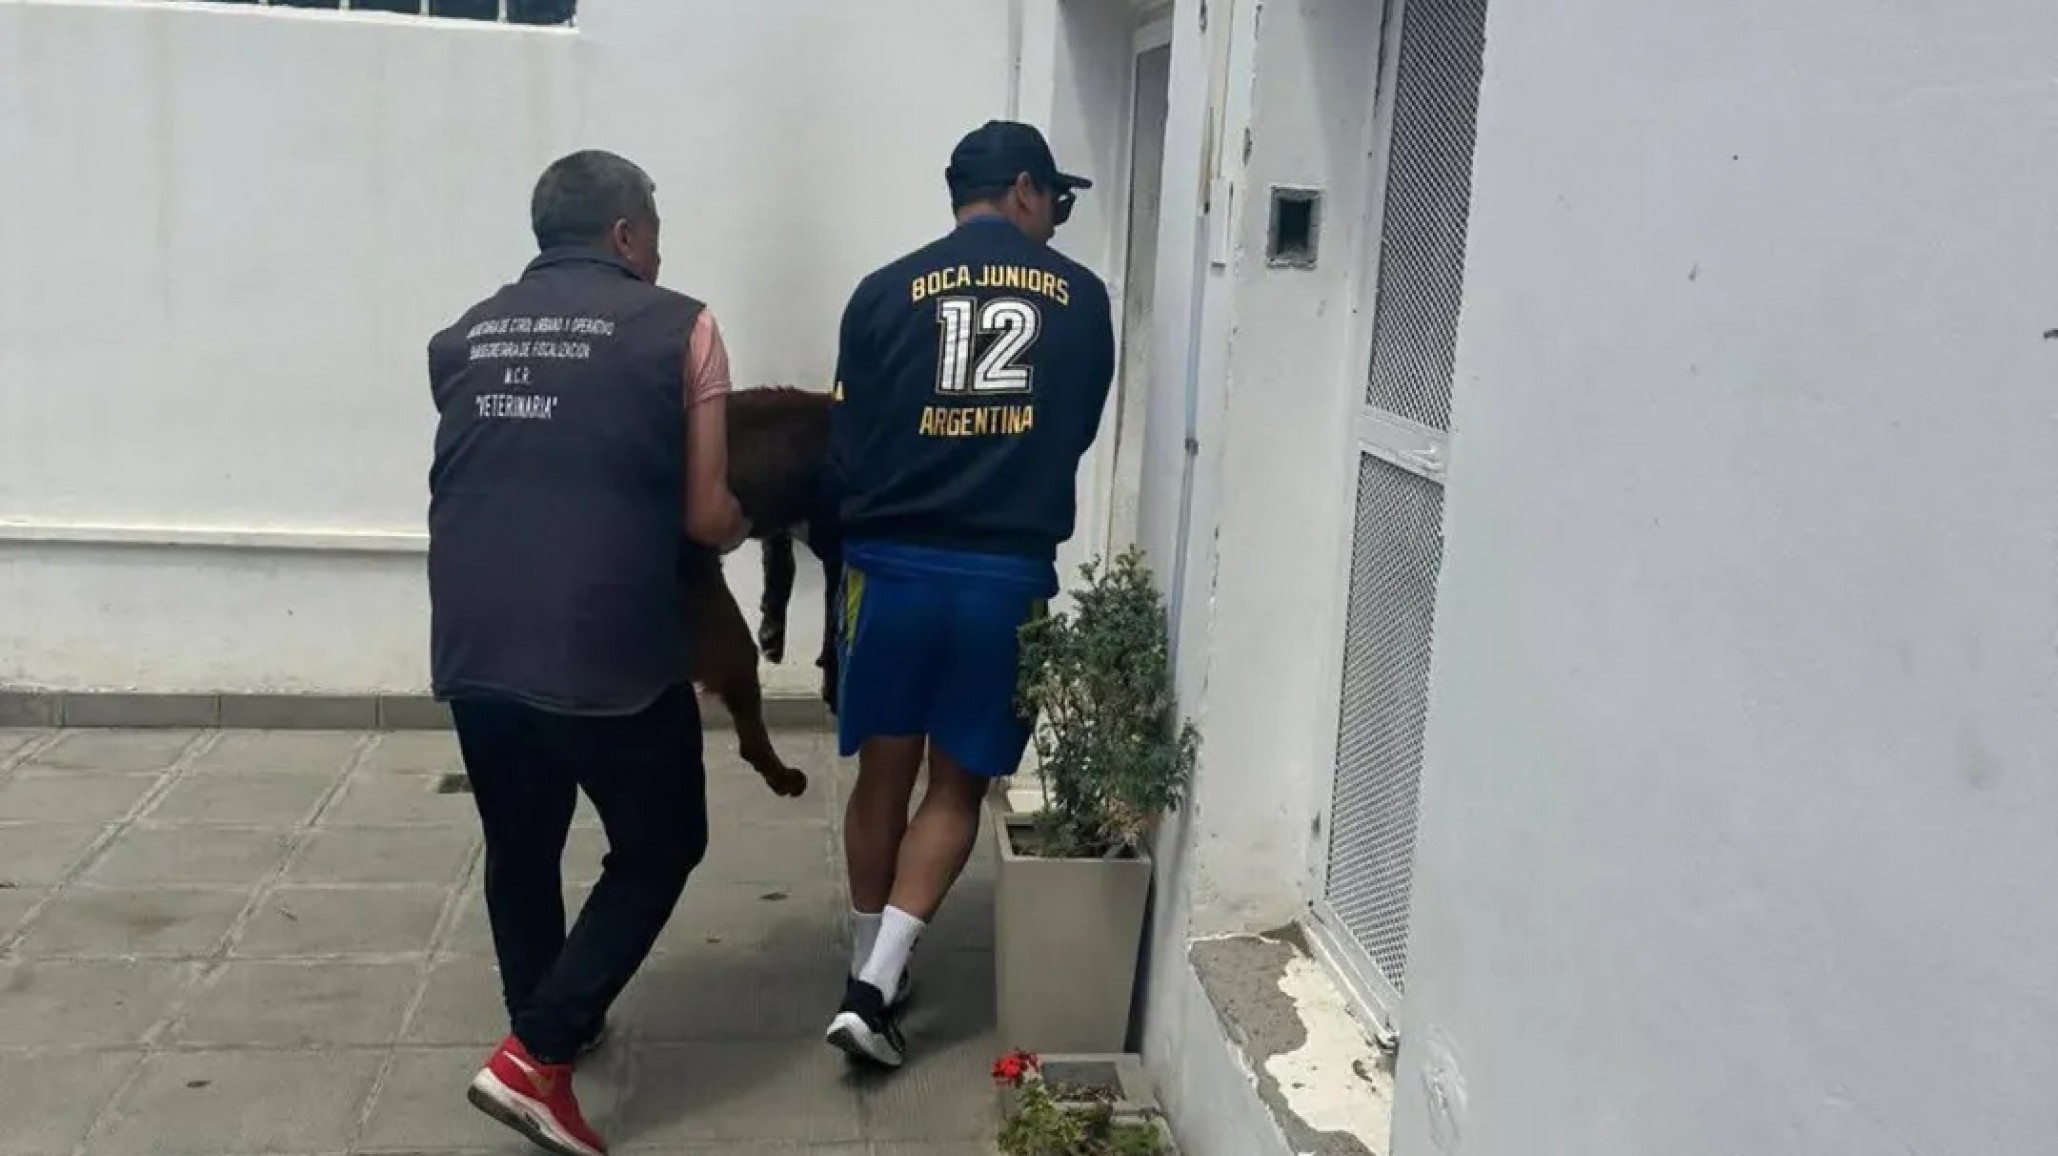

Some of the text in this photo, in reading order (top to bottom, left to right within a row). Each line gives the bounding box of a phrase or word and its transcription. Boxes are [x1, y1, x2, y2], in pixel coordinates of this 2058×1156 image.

[911, 264, 1070, 306] BOCA JUNIORS
[936, 296, 1040, 395] 12
[920, 405, 1034, 436] ARGENTINA
